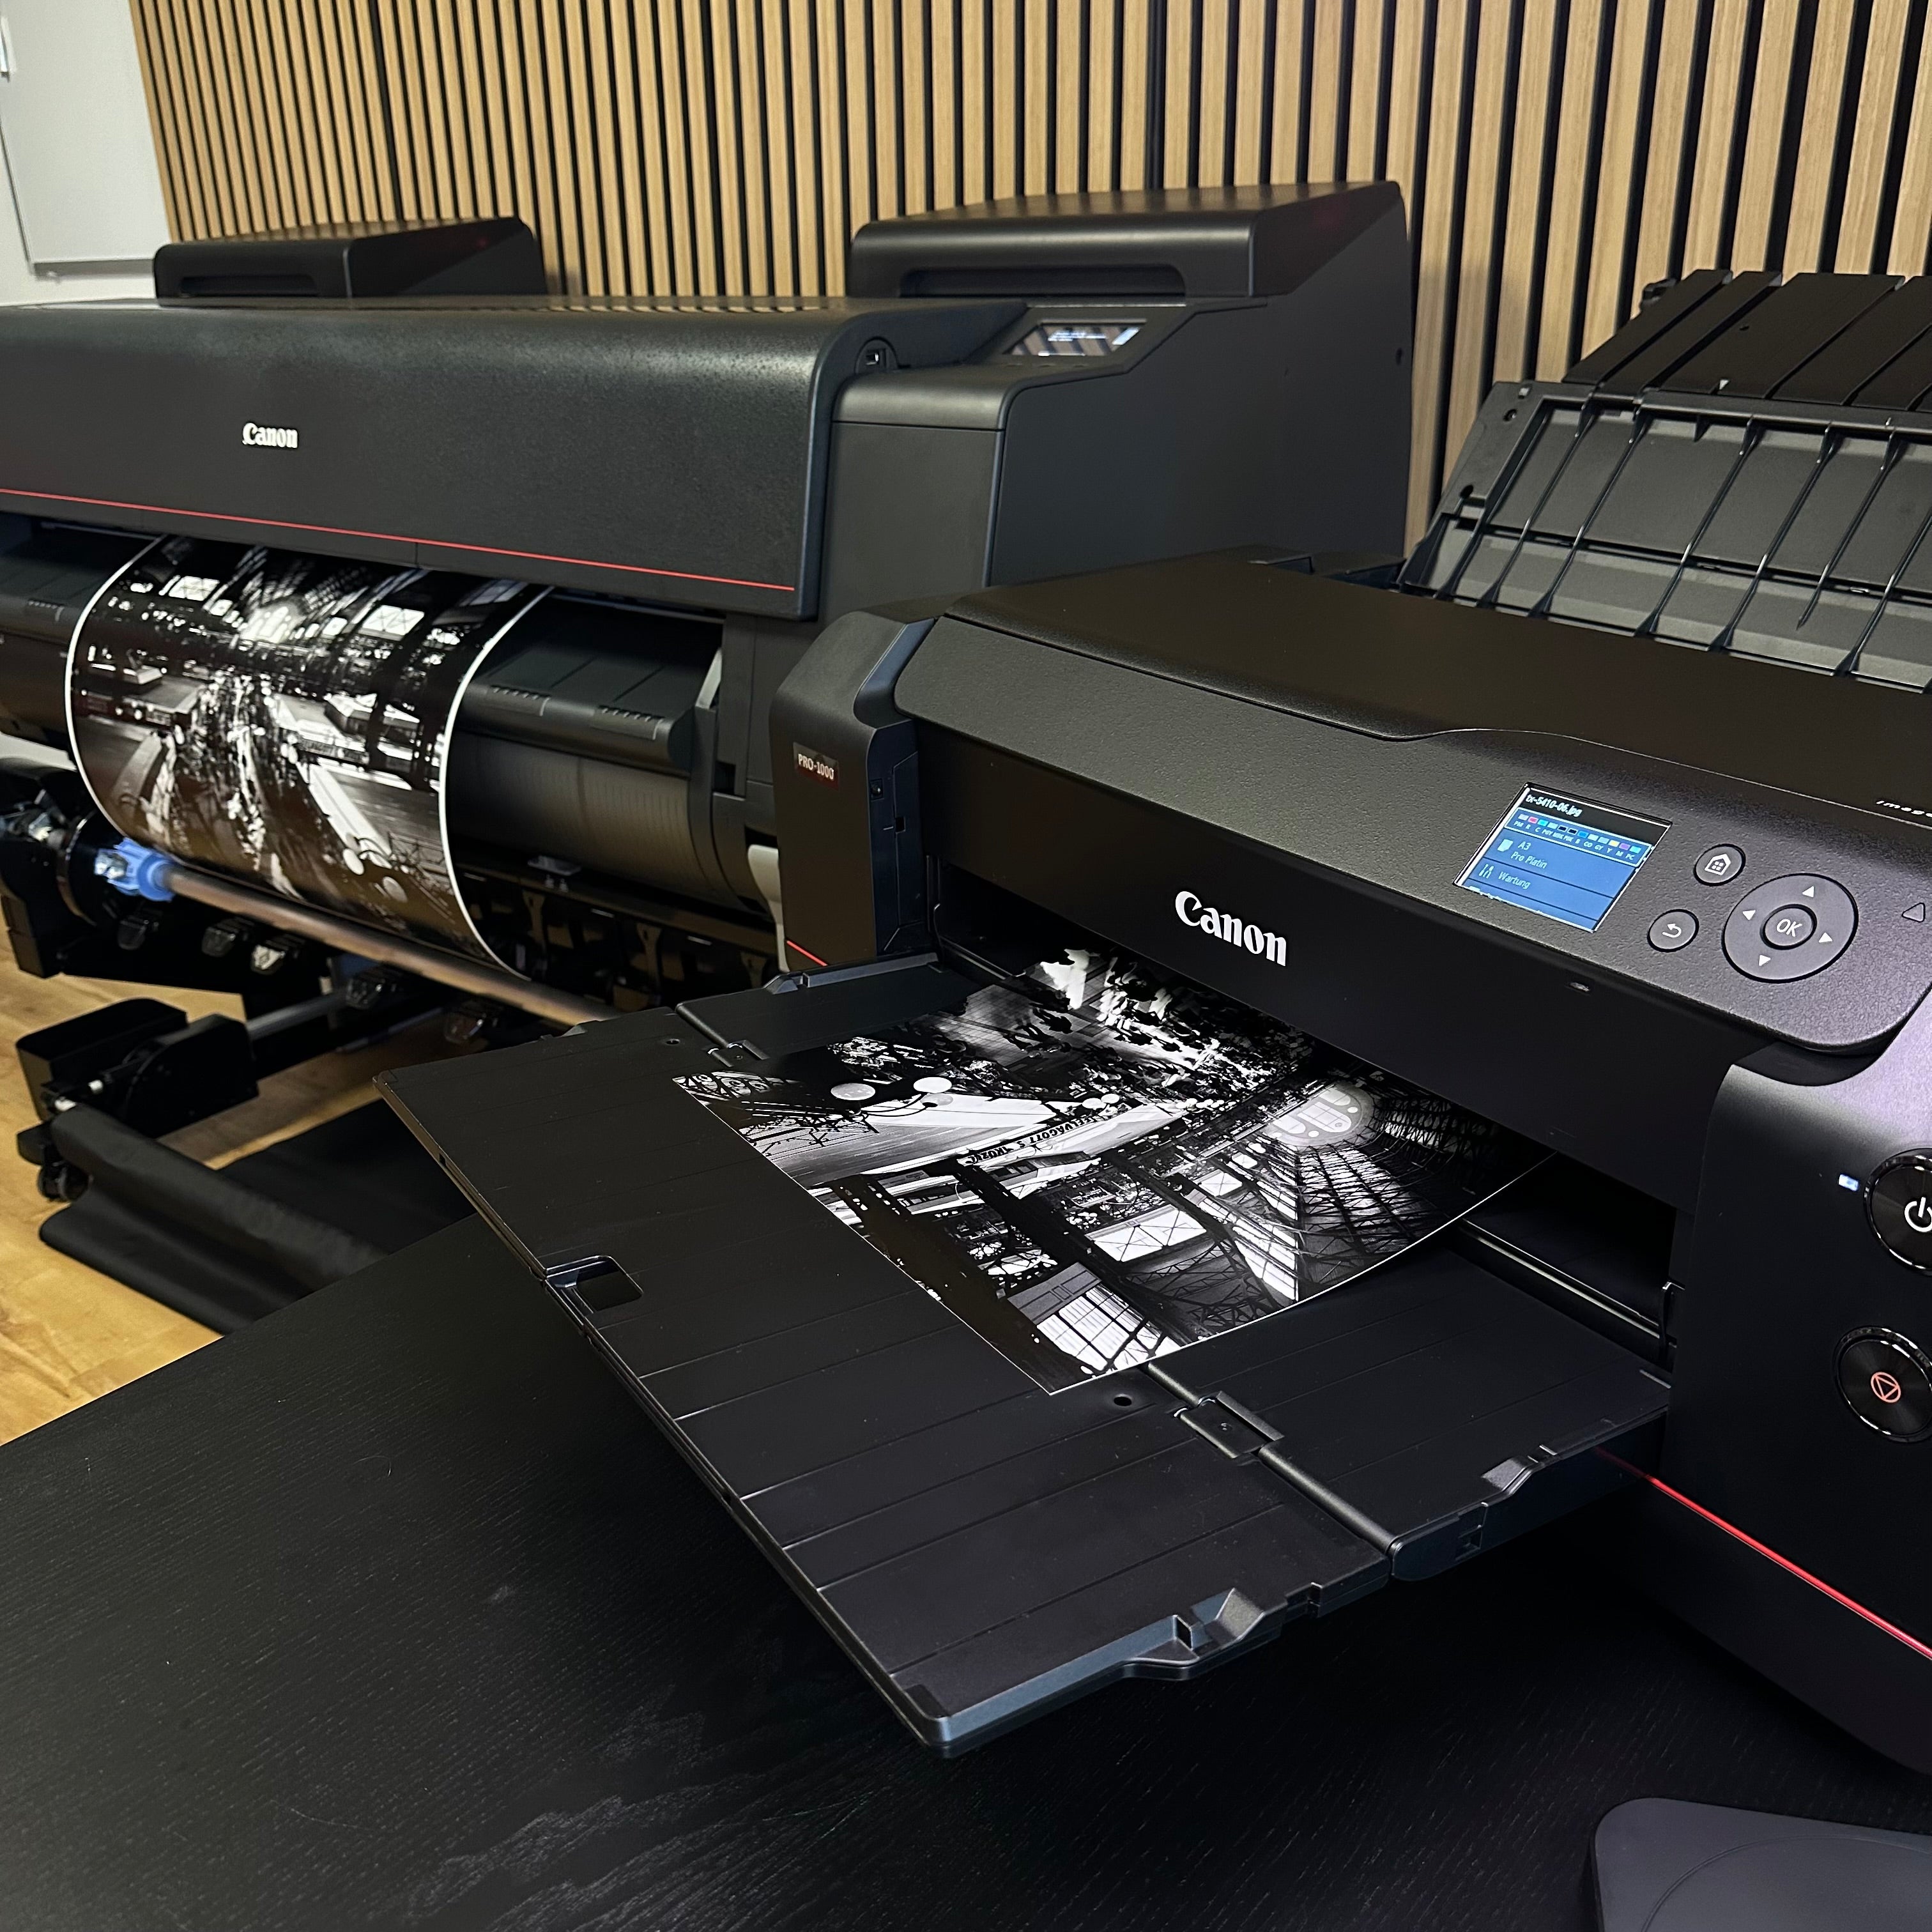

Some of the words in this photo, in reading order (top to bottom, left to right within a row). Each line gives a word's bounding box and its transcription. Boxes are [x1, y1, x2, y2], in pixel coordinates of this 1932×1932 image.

[242, 422, 298, 448] Canon
[798, 753, 834, 780] PRO-1000
[1517, 841, 1531, 850] A3
[1510, 851, 1525, 862] Pro
[1524, 855, 1547, 869] Platin
[1498, 871, 1531, 890] Wartung
[1175, 891, 1287, 967] Canon
[1776, 919, 1802, 937] OK
